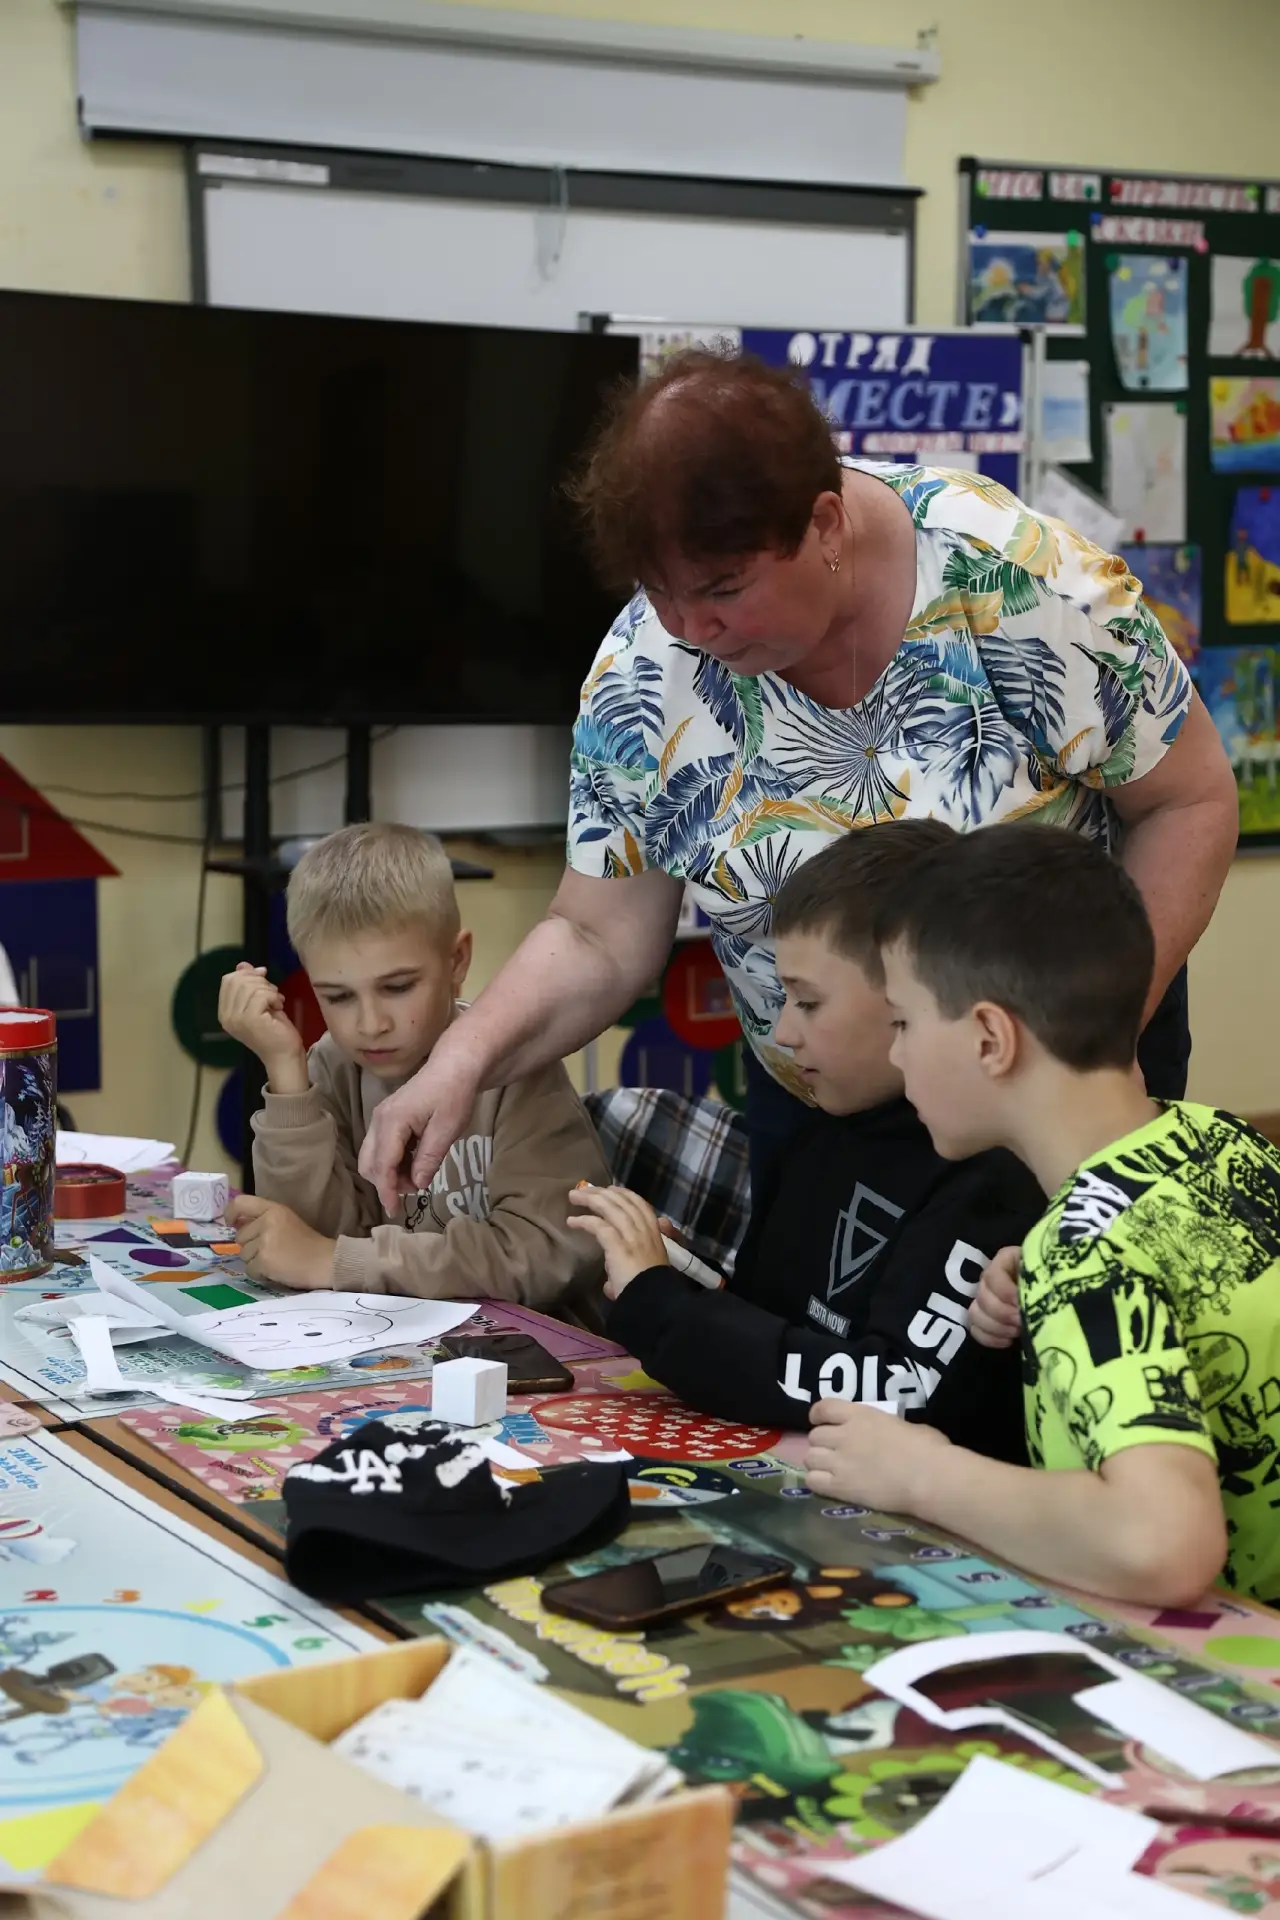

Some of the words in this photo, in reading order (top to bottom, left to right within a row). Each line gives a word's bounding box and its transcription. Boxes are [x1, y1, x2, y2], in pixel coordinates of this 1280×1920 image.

[787, 332, 937, 376] ОТРЯД
[808, 1299, 828, 1324] DISTR
[827, 1311, 847, 1335] NOW
[335, 1448, 403, 1495] LA
[727, 1459, 786, 1479] 10
[820, 1505, 871, 1518] 8
[955, 1571, 1007, 1584] 5
